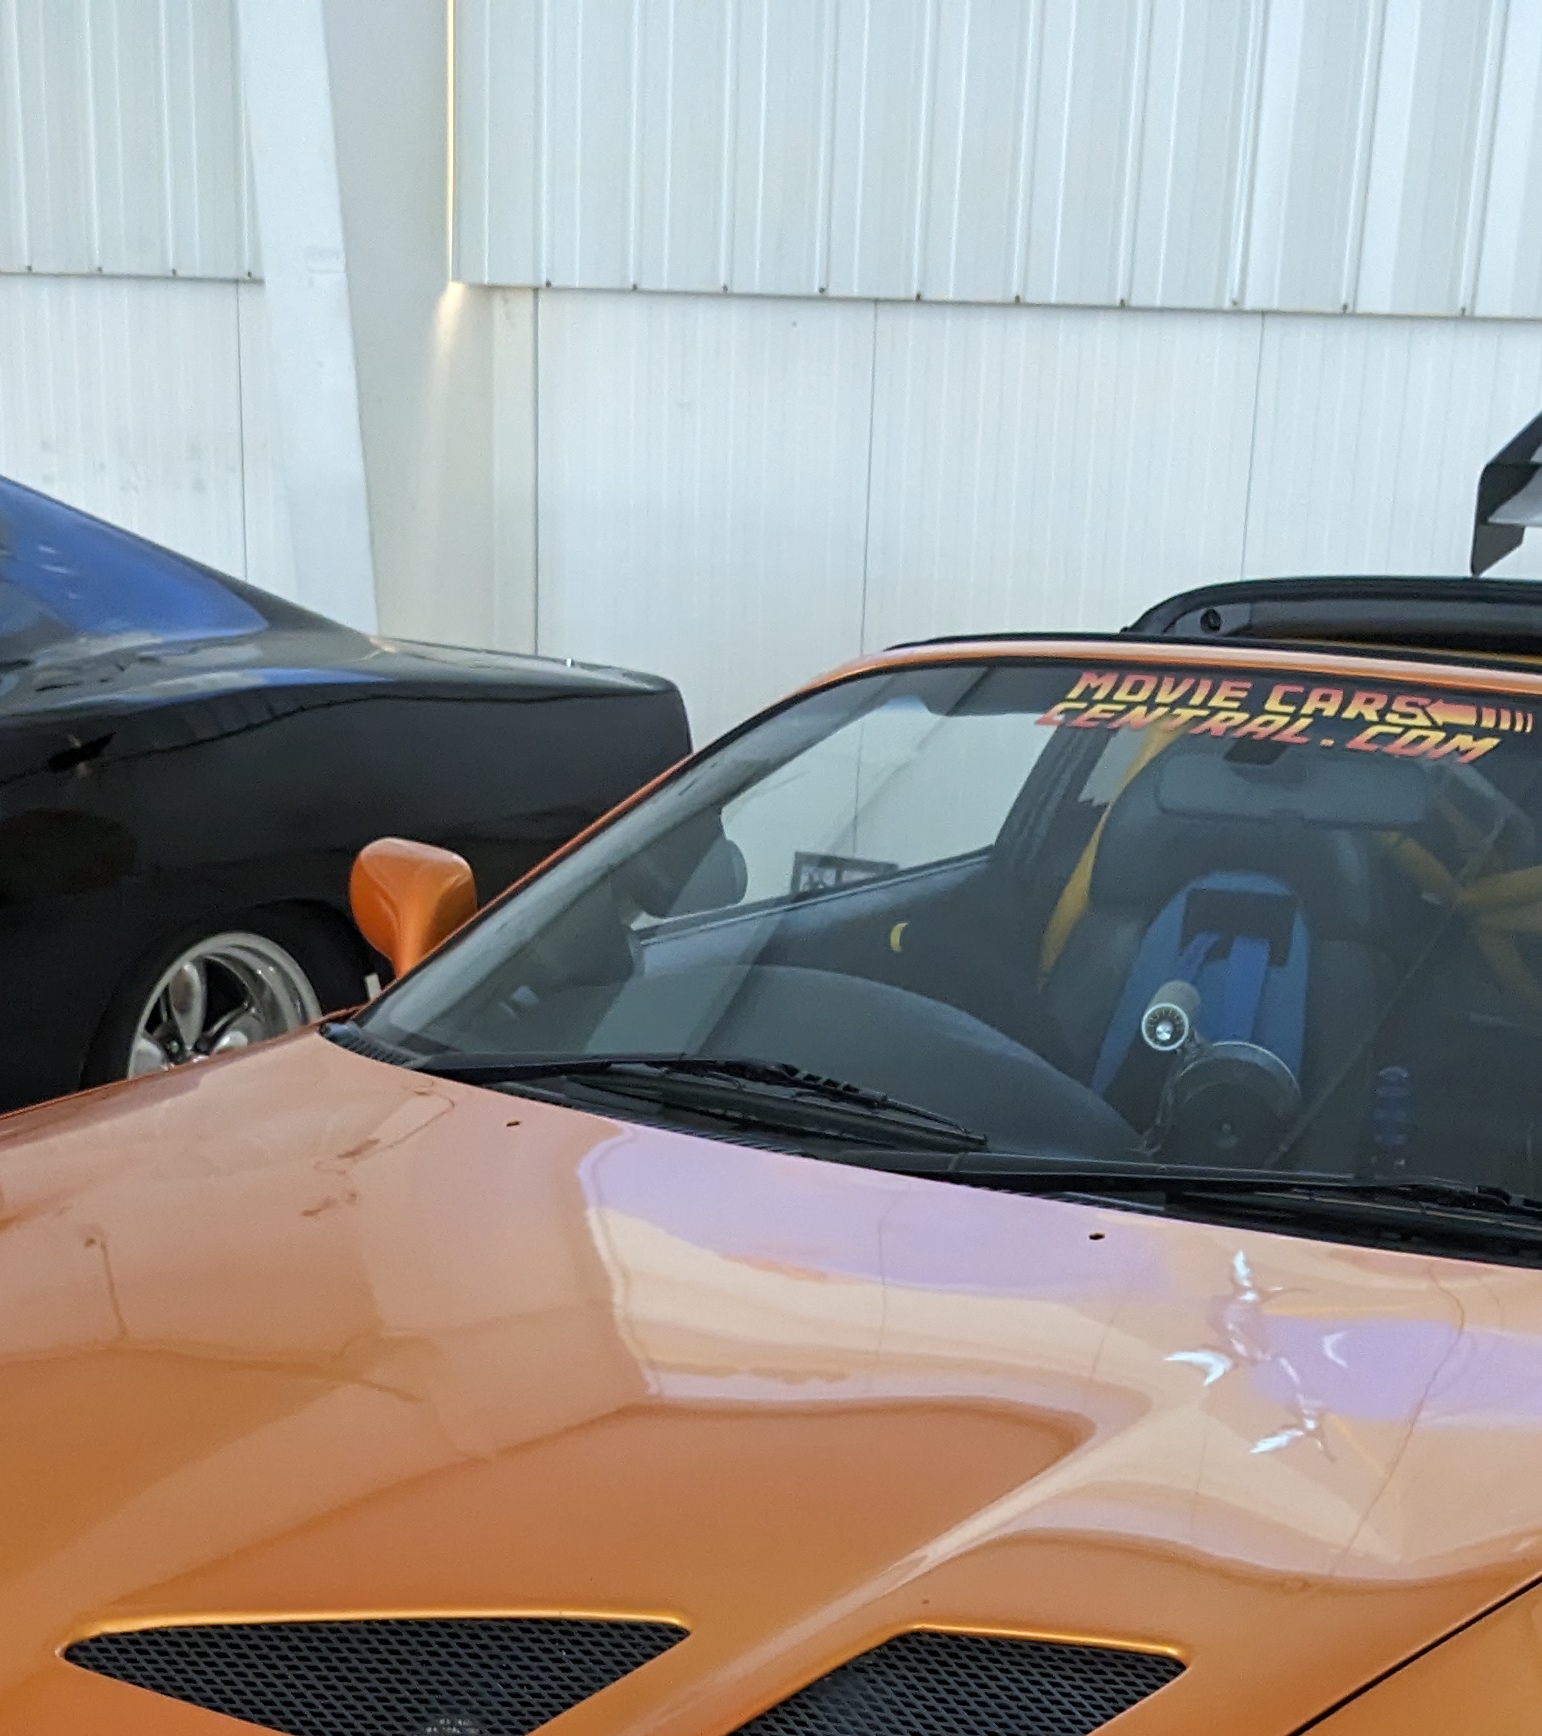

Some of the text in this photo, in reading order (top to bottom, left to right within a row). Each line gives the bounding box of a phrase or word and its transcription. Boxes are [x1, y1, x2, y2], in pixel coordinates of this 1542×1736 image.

[1066, 671, 1433, 727] MOVIE CARS
[1035, 701, 1502, 764] CENTRAL.COM
